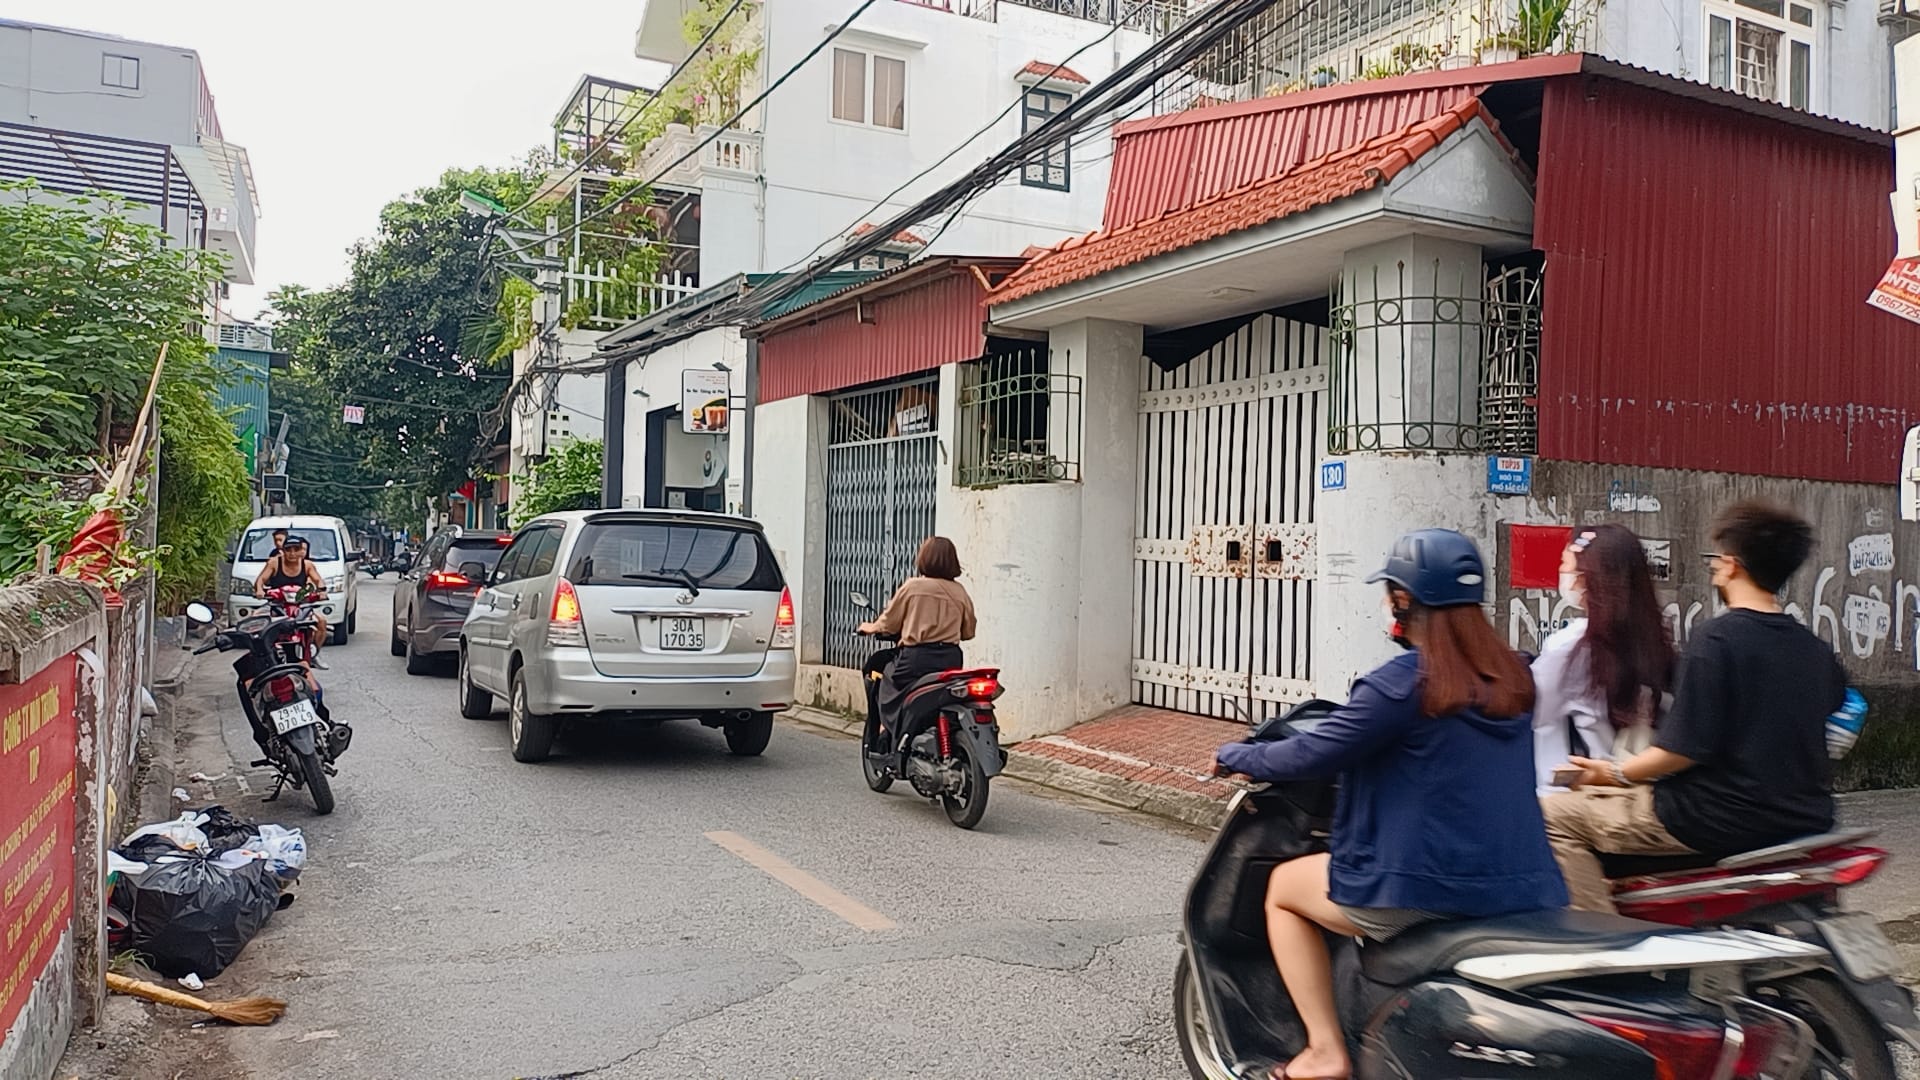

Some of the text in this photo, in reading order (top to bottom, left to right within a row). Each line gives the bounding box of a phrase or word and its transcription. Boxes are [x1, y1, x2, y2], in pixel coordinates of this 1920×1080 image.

[1324, 465, 1342, 486] 180
[672, 618, 694, 632] 30A
[665, 633, 703, 647] 170.35
